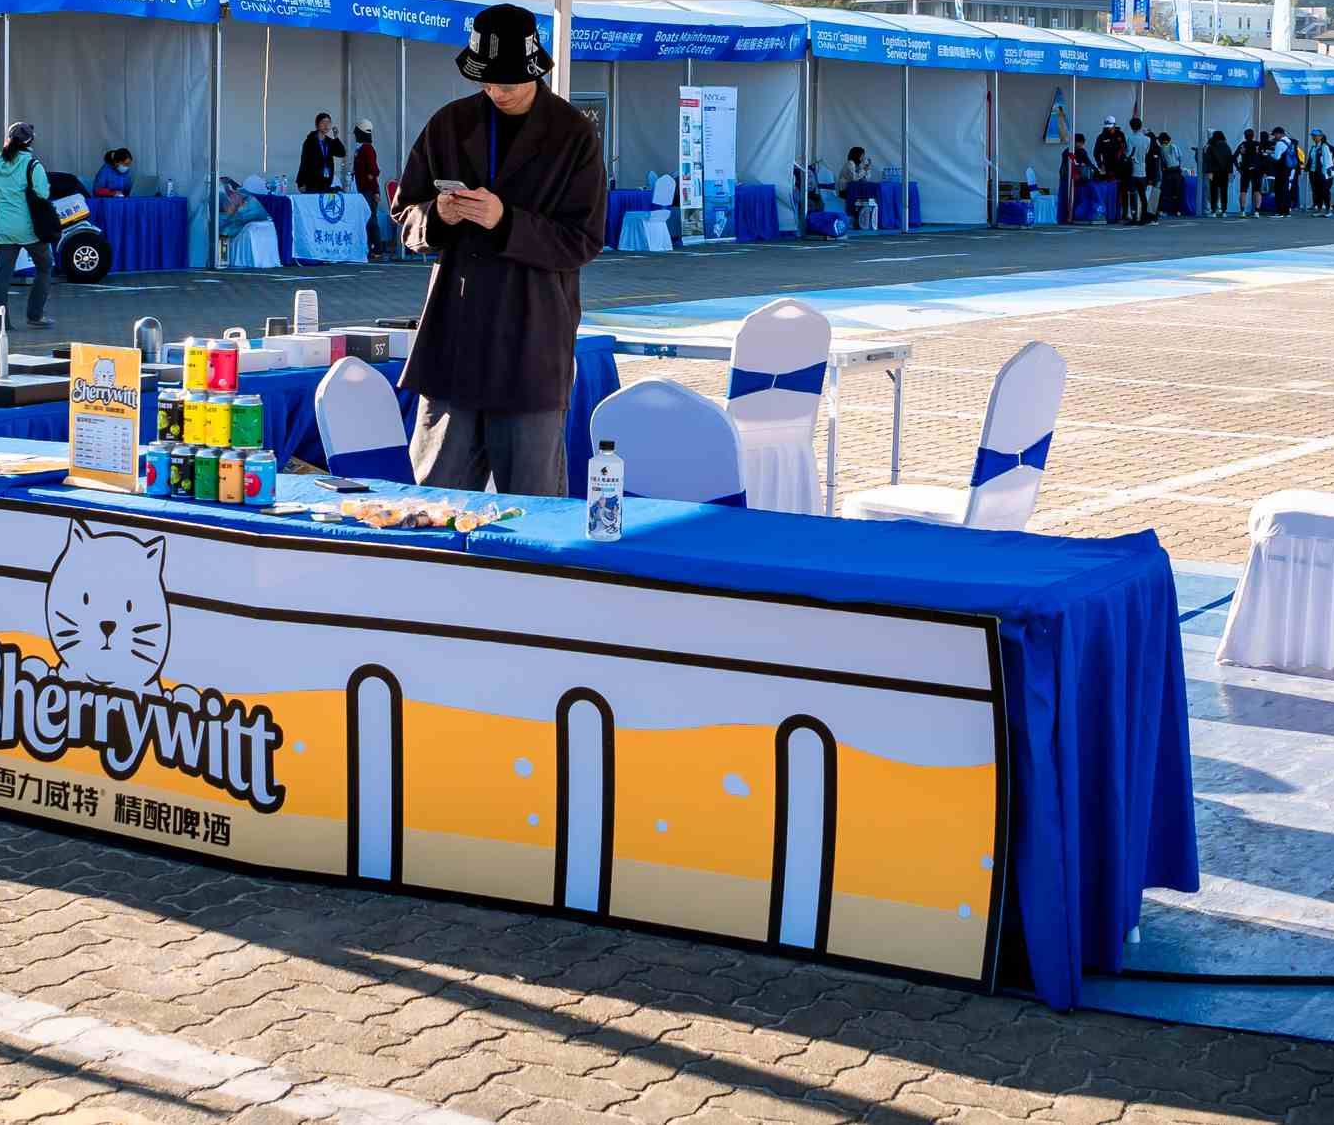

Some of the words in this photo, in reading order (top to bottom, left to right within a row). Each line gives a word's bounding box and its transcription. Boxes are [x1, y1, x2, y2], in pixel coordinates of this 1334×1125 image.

[240, 1, 276, 13] CHINA
[276, 5, 298, 15] CUP
[352, 2, 380, 19] Crew
[382, 6, 417, 24] Service
[419, 11, 451, 28] Center
[654, 31, 679, 44] Boats
[679, 32, 730, 44] Maintenance
[71, 377, 138, 409] Sherrywitt
[114, 792, 231, 847] 精酿啤酒
